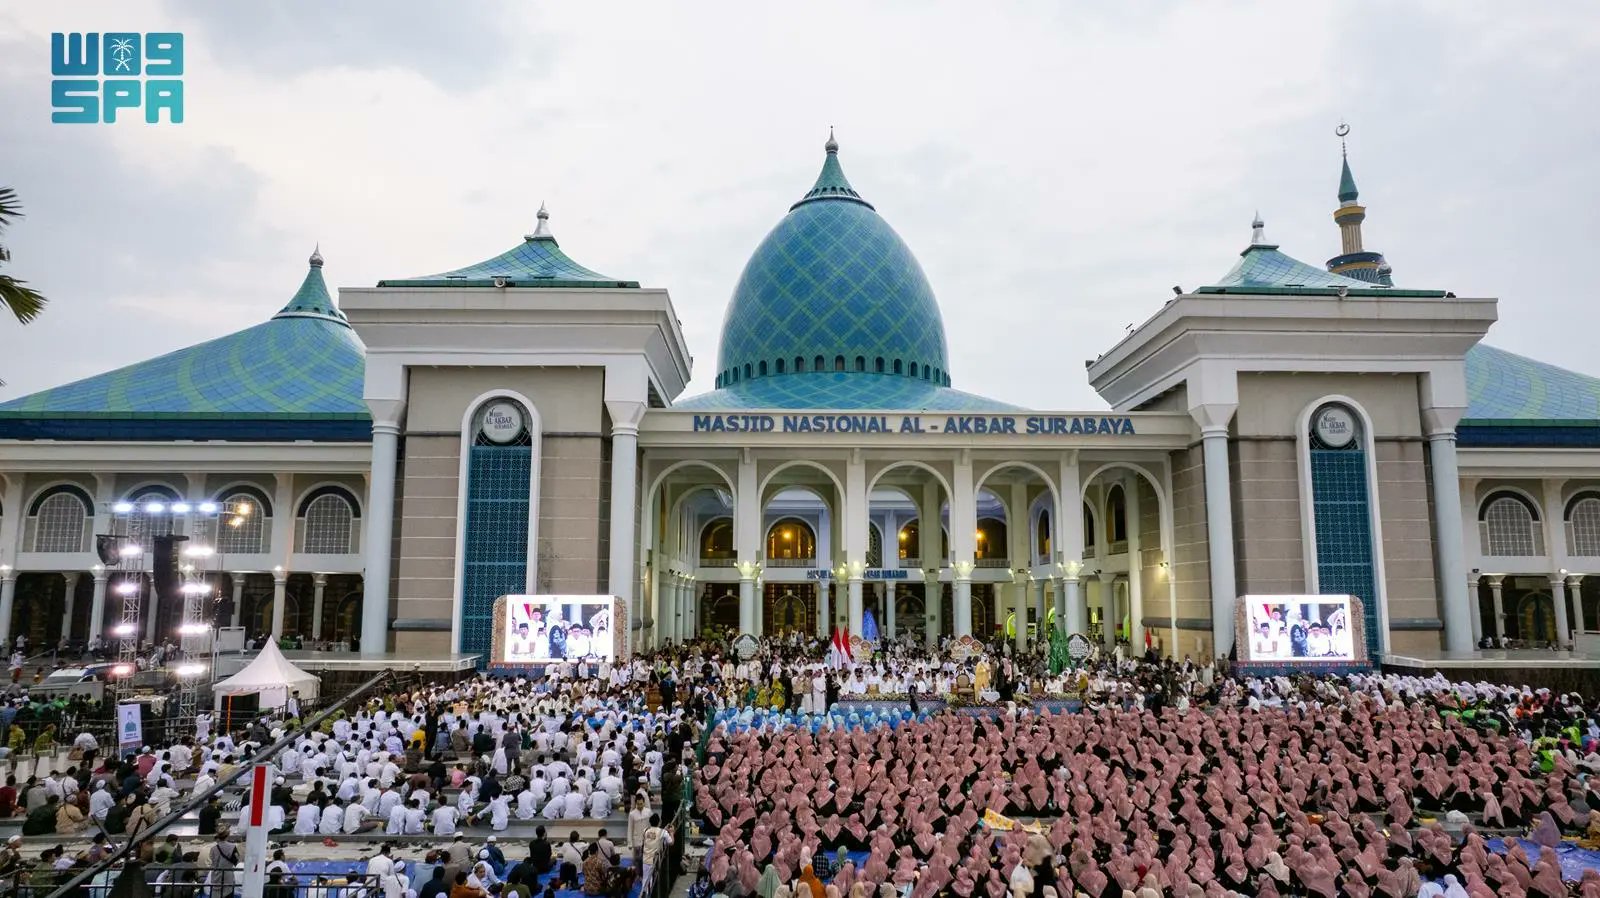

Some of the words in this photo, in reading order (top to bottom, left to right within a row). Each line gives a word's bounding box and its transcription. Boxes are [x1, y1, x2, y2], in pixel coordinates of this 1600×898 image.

[693, 415, 774, 432] MASJID
[783, 415, 892, 433] NASIONAL
[1026, 417, 1135, 435] SURABAYA
